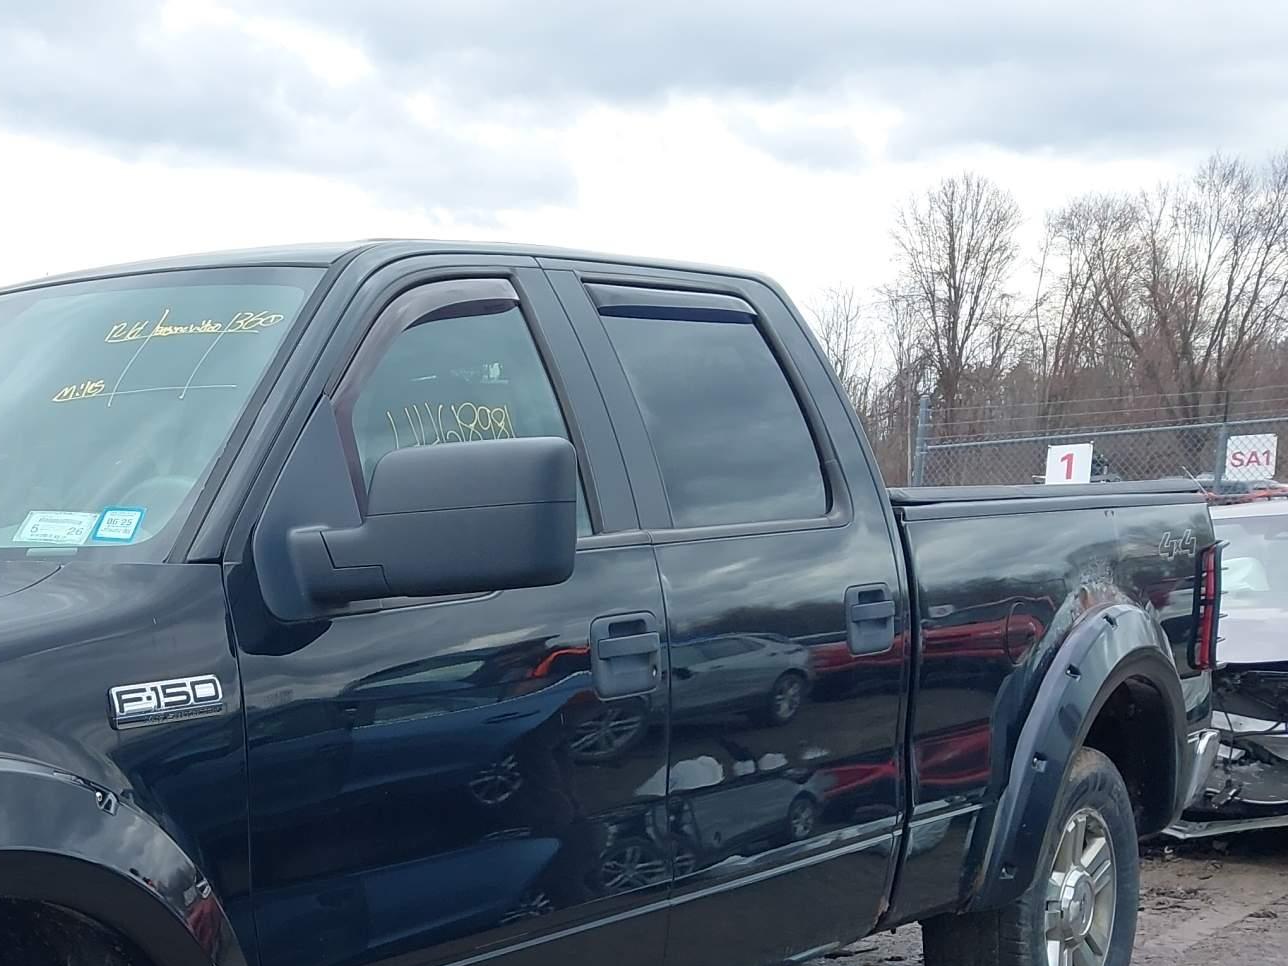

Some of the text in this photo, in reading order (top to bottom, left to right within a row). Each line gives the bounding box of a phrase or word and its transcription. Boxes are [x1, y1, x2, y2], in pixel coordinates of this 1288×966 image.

[1060, 453, 1074, 480] 1
[1231, 450, 1271, 467] SA1
[1159, 529, 1196, 561] 4x4
[115, 679, 219, 714] F-150
